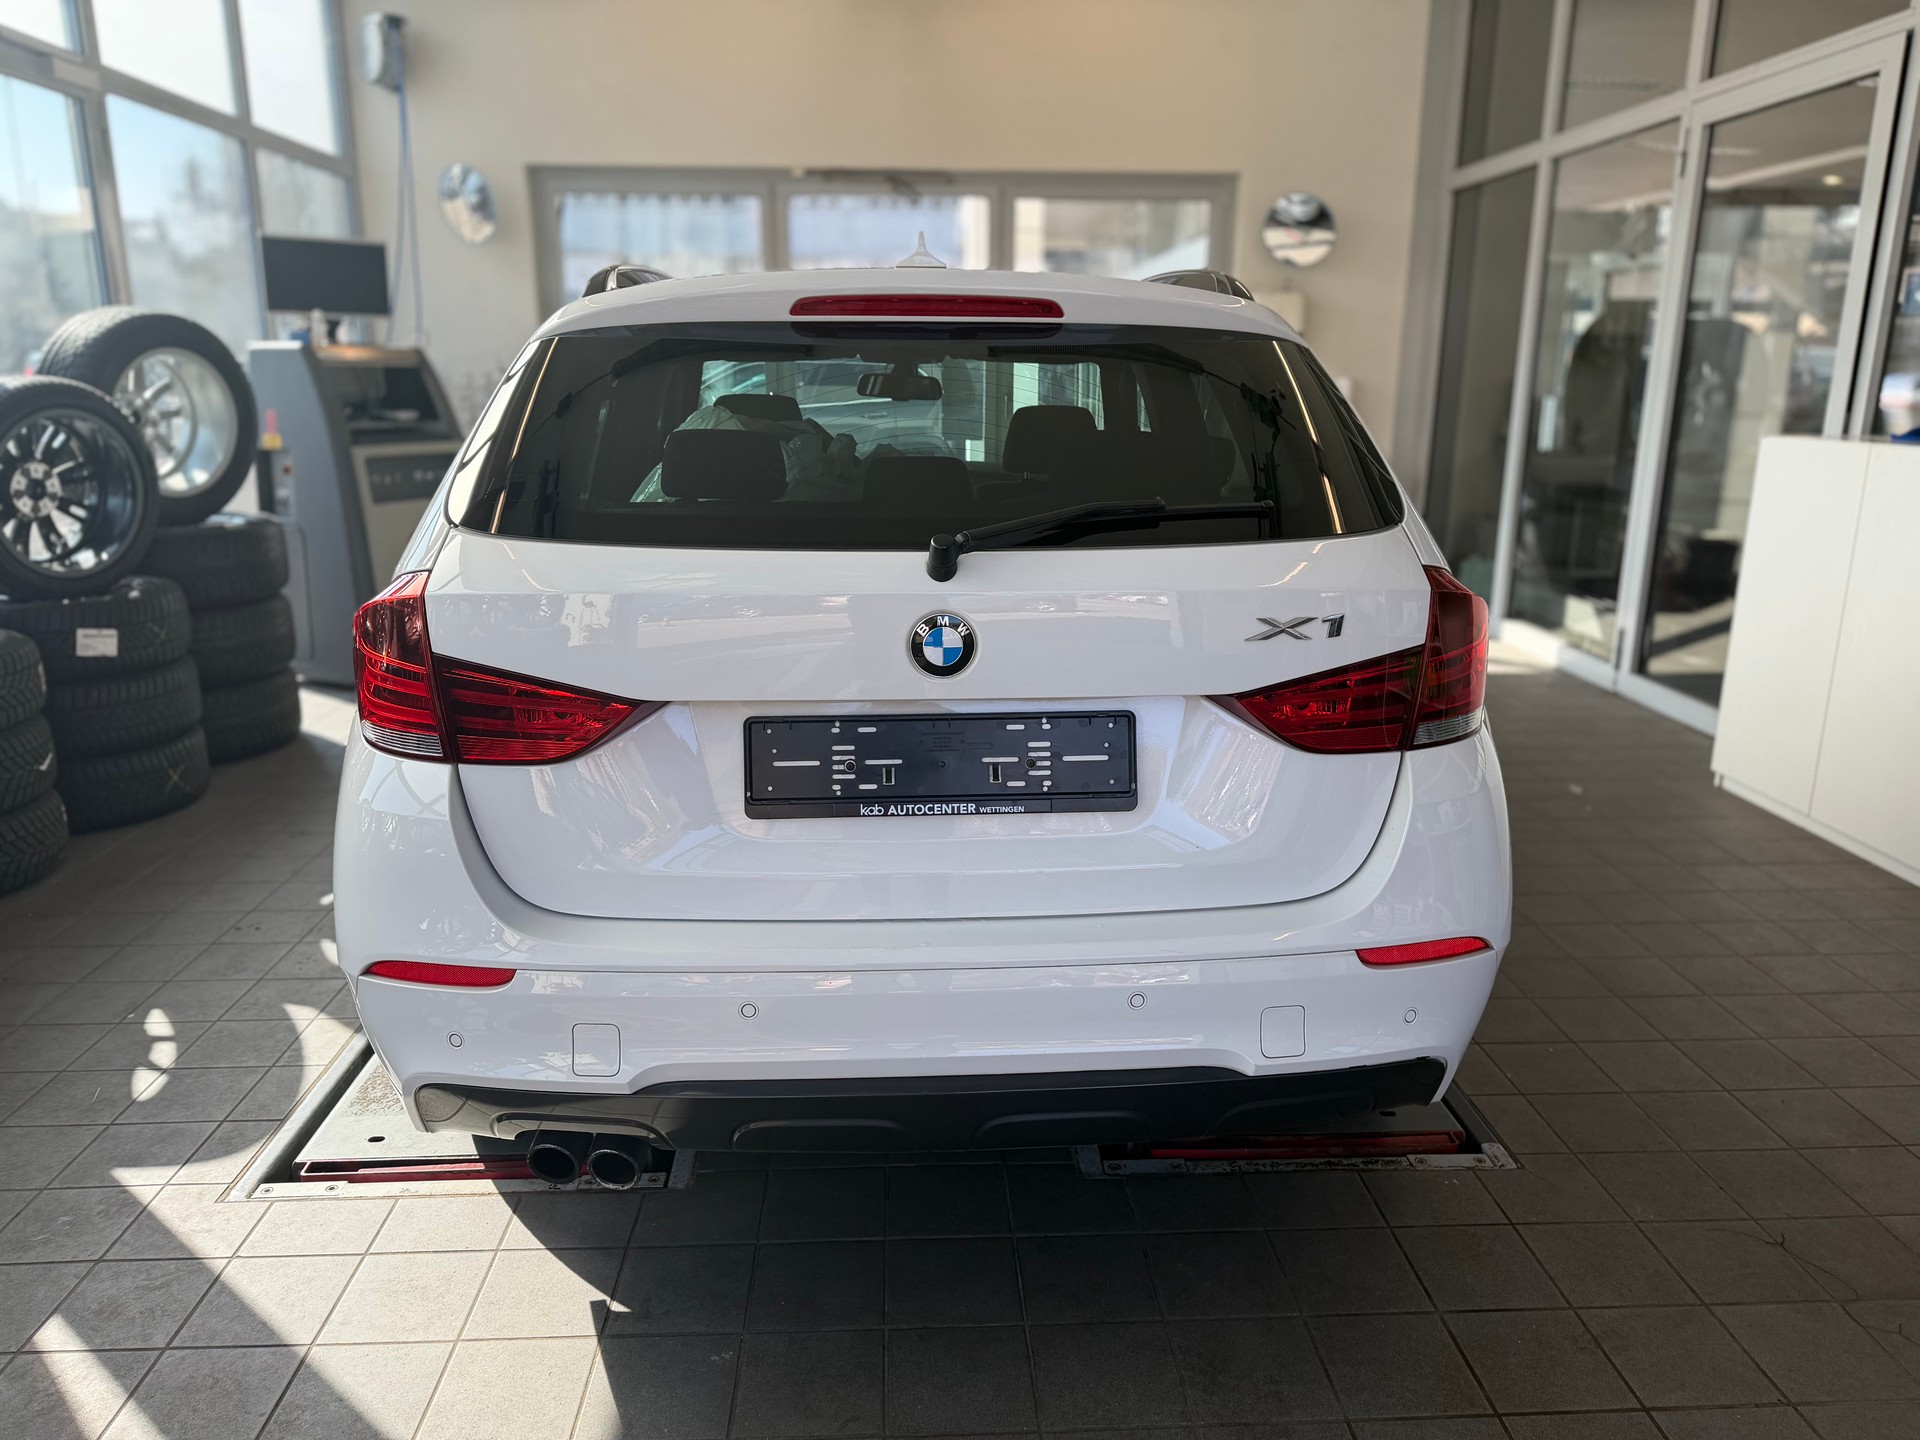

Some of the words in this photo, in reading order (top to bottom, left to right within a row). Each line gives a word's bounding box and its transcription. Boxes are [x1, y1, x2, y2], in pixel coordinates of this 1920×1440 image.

[916, 615, 970, 637] BMW
[1244, 613, 1345, 641] X1
[860, 803, 885, 816] kab
[887, 803, 976, 816] AUTOCENTER
[979, 805, 1025, 814] WETTINGEN
